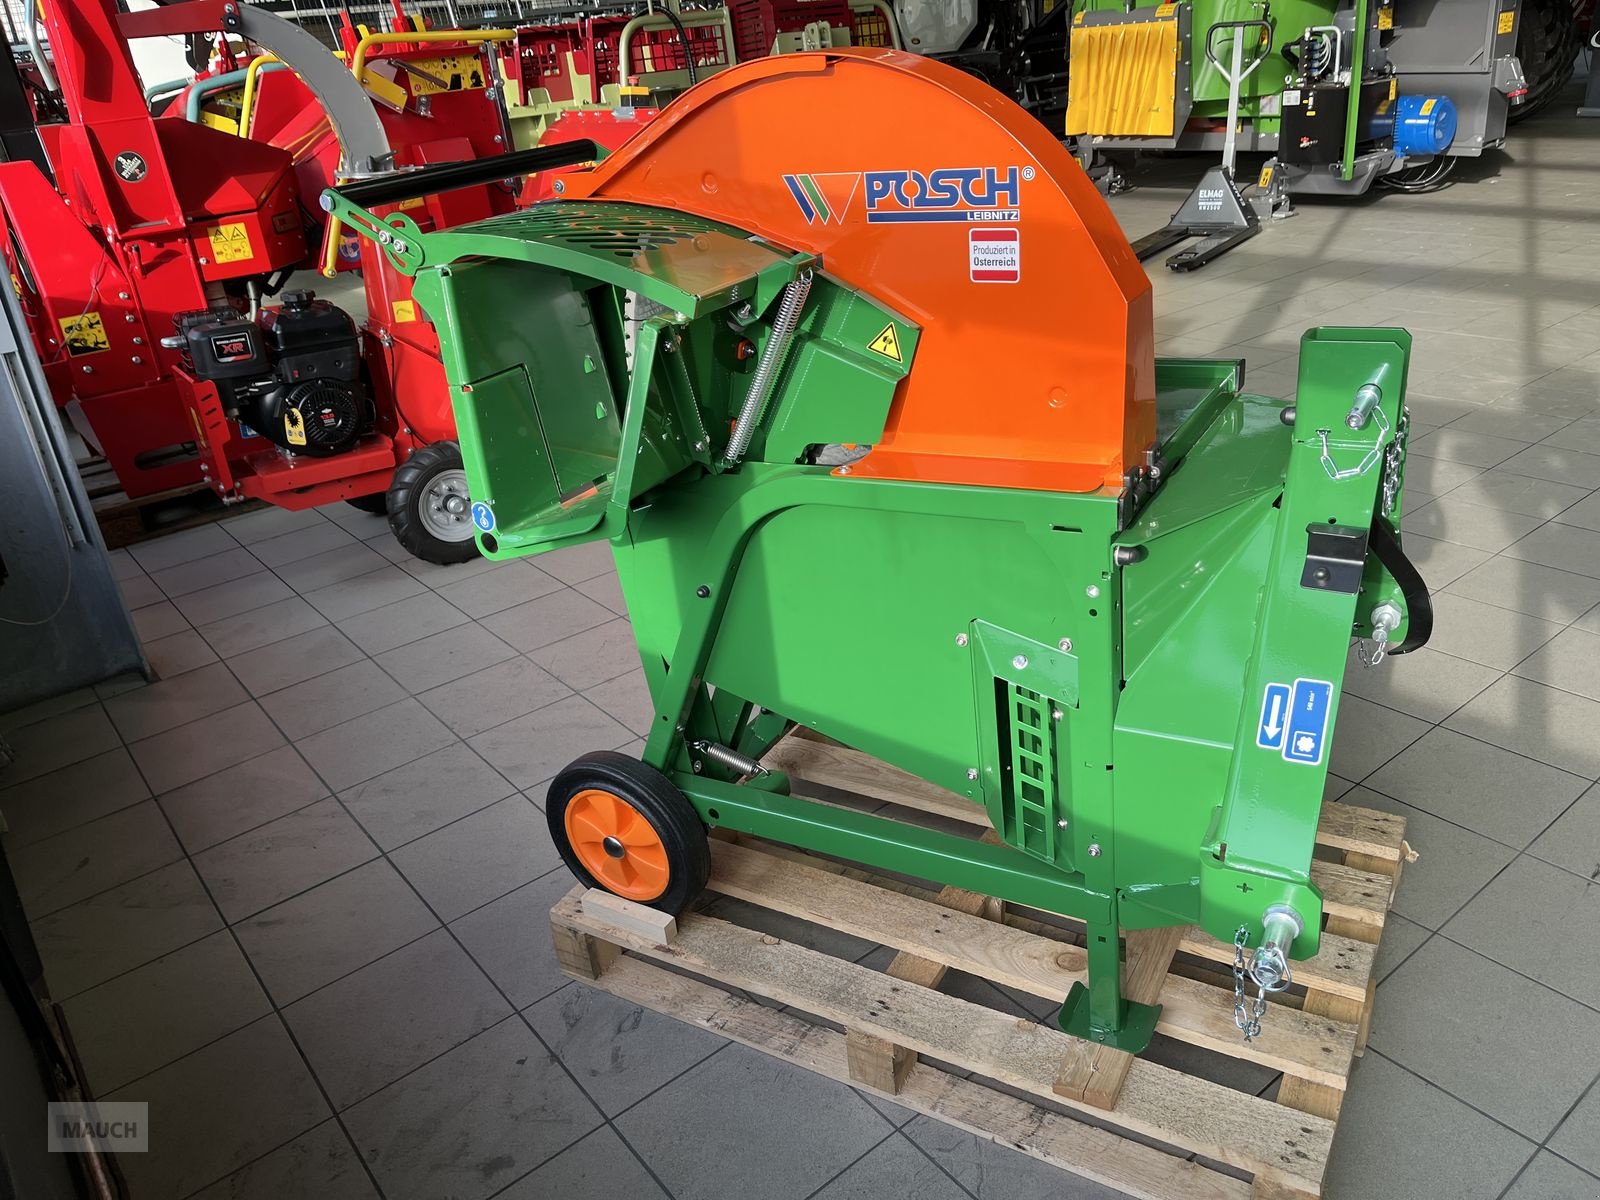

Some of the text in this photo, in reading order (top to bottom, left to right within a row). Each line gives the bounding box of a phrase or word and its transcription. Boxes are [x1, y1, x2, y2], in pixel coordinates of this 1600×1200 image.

[1199, 189, 1223, 198] ELMAG
[967, 211, 1018, 220] LEIBNITZ
[973, 245, 1016, 255] Produziert in
[221, 342, 244, 354] XR
